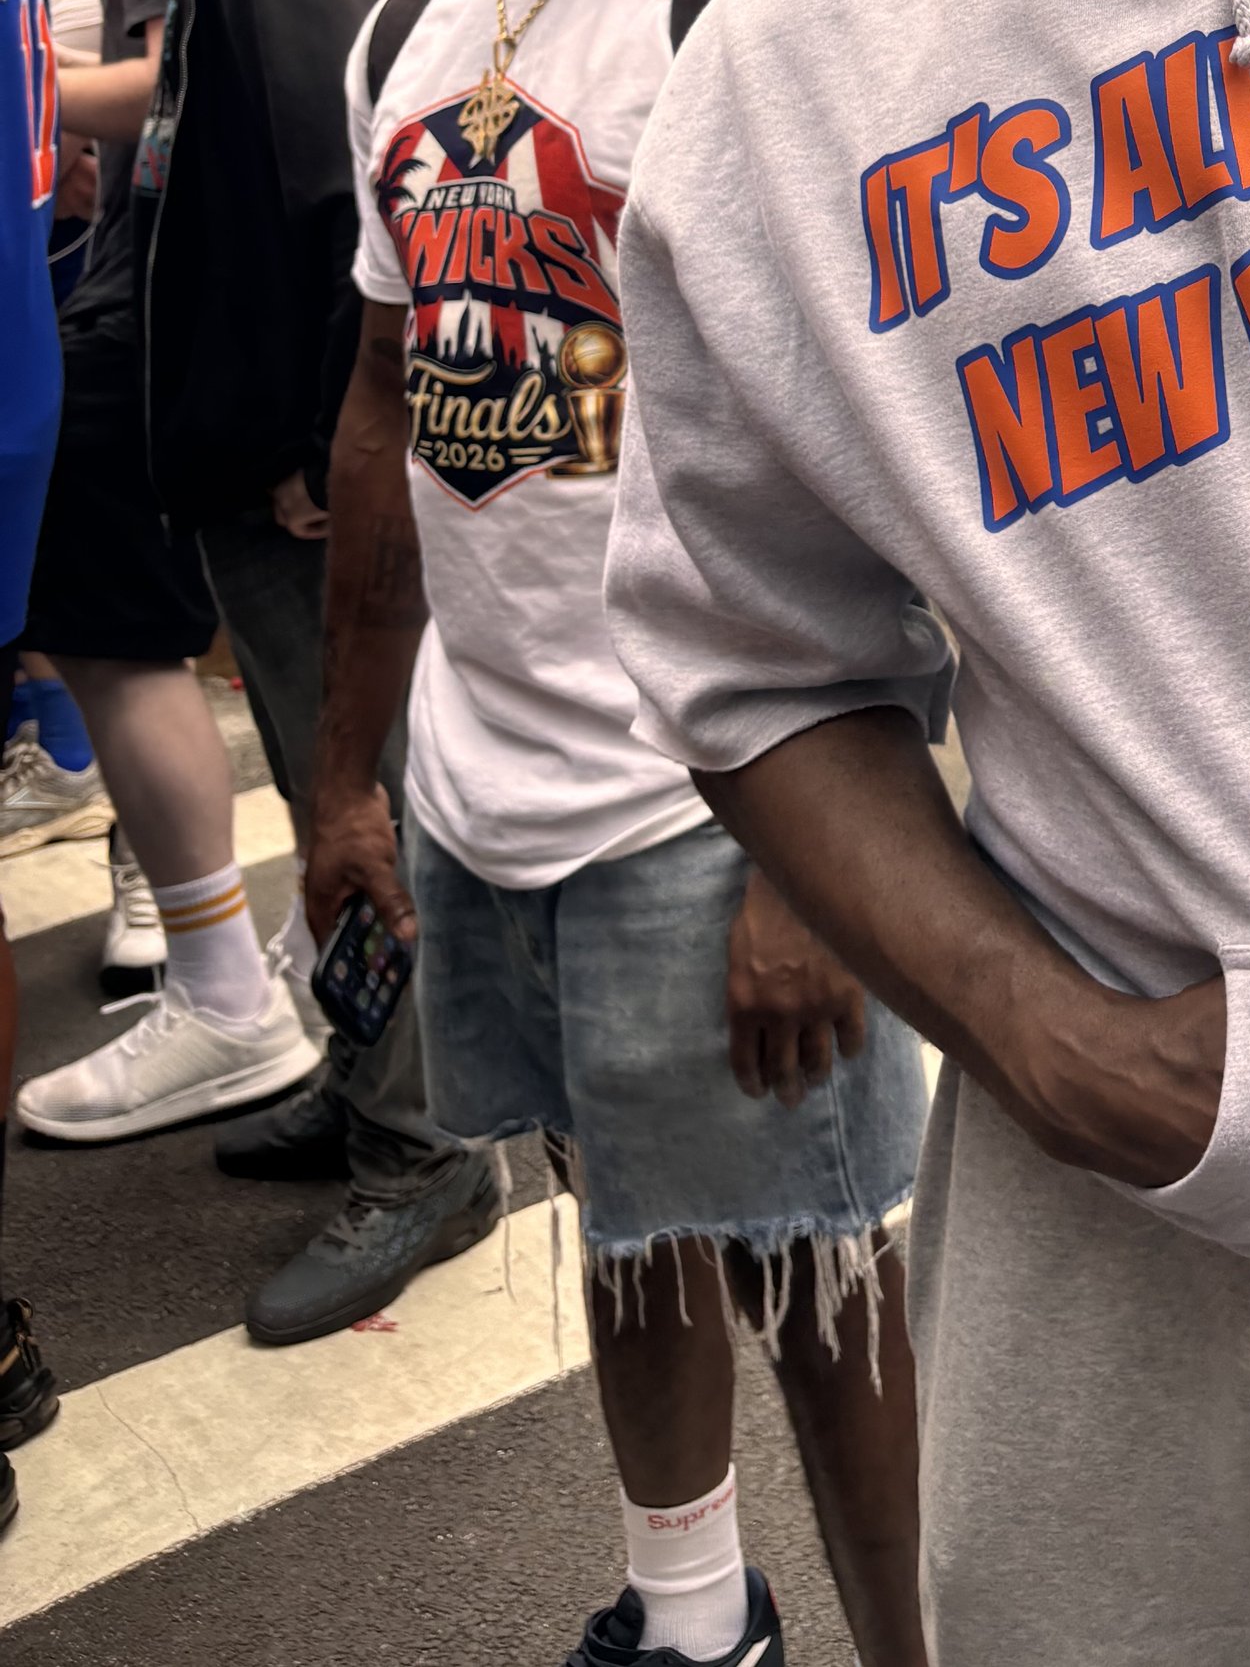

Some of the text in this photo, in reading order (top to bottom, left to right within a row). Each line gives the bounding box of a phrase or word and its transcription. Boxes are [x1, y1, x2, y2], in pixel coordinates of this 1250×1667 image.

[427, 183, 514, 209] NEW YORK
[860, 98, 1072, 335] IT'S
[405, 359, 573, 456] Finals
[956, 264, 1231, 533] NEW
[434, 442, 505, 472] 2026
